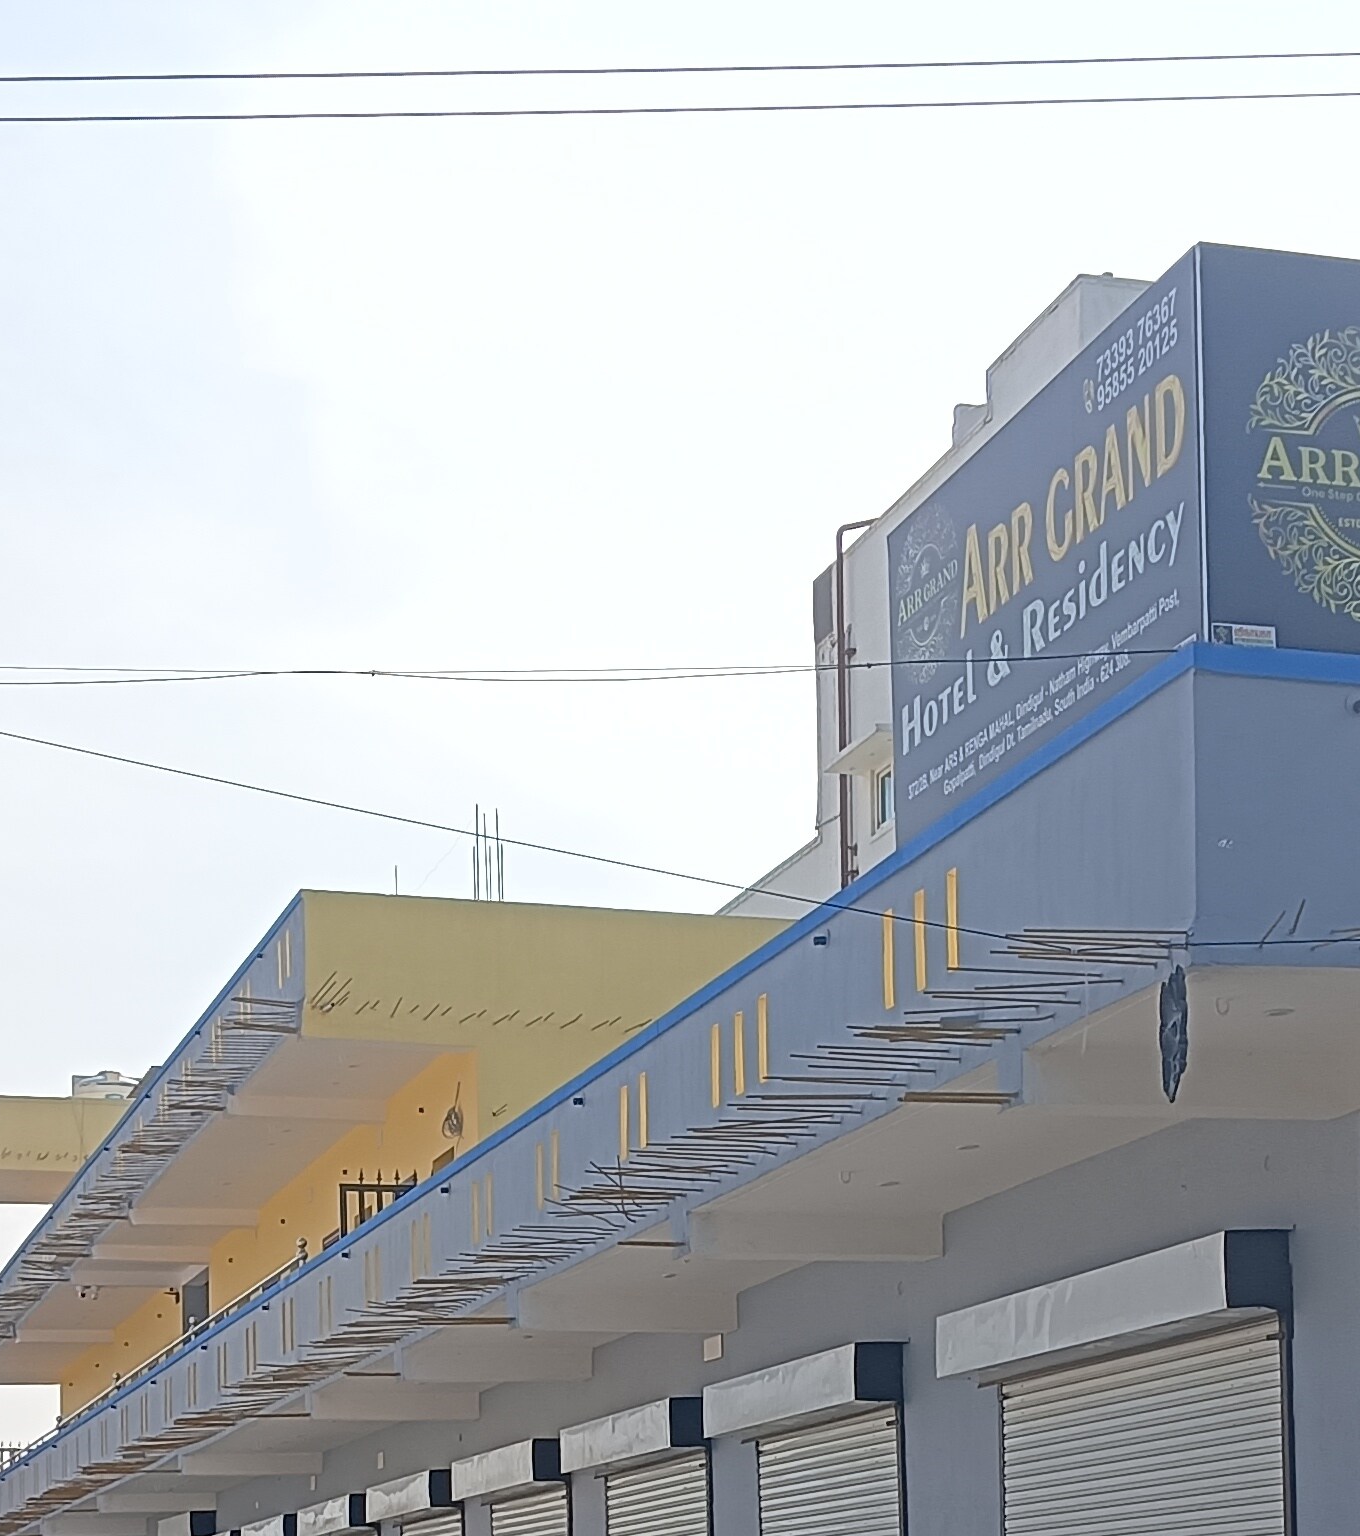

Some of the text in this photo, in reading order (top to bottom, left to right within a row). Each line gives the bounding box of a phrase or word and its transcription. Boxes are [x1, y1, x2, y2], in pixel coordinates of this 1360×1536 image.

[1096, 287, 1177, 382] 73393 76367
[1097, 318, 1177, 411] 95855 20125
[960, 373, 1186, 640] ARR GRAND
[1302, 486, 1325, 499] One
[1328, 488, 1354, 503] Step
[923, 559, 958, 602] GRAND
[987, 628, 1011, 687] &
